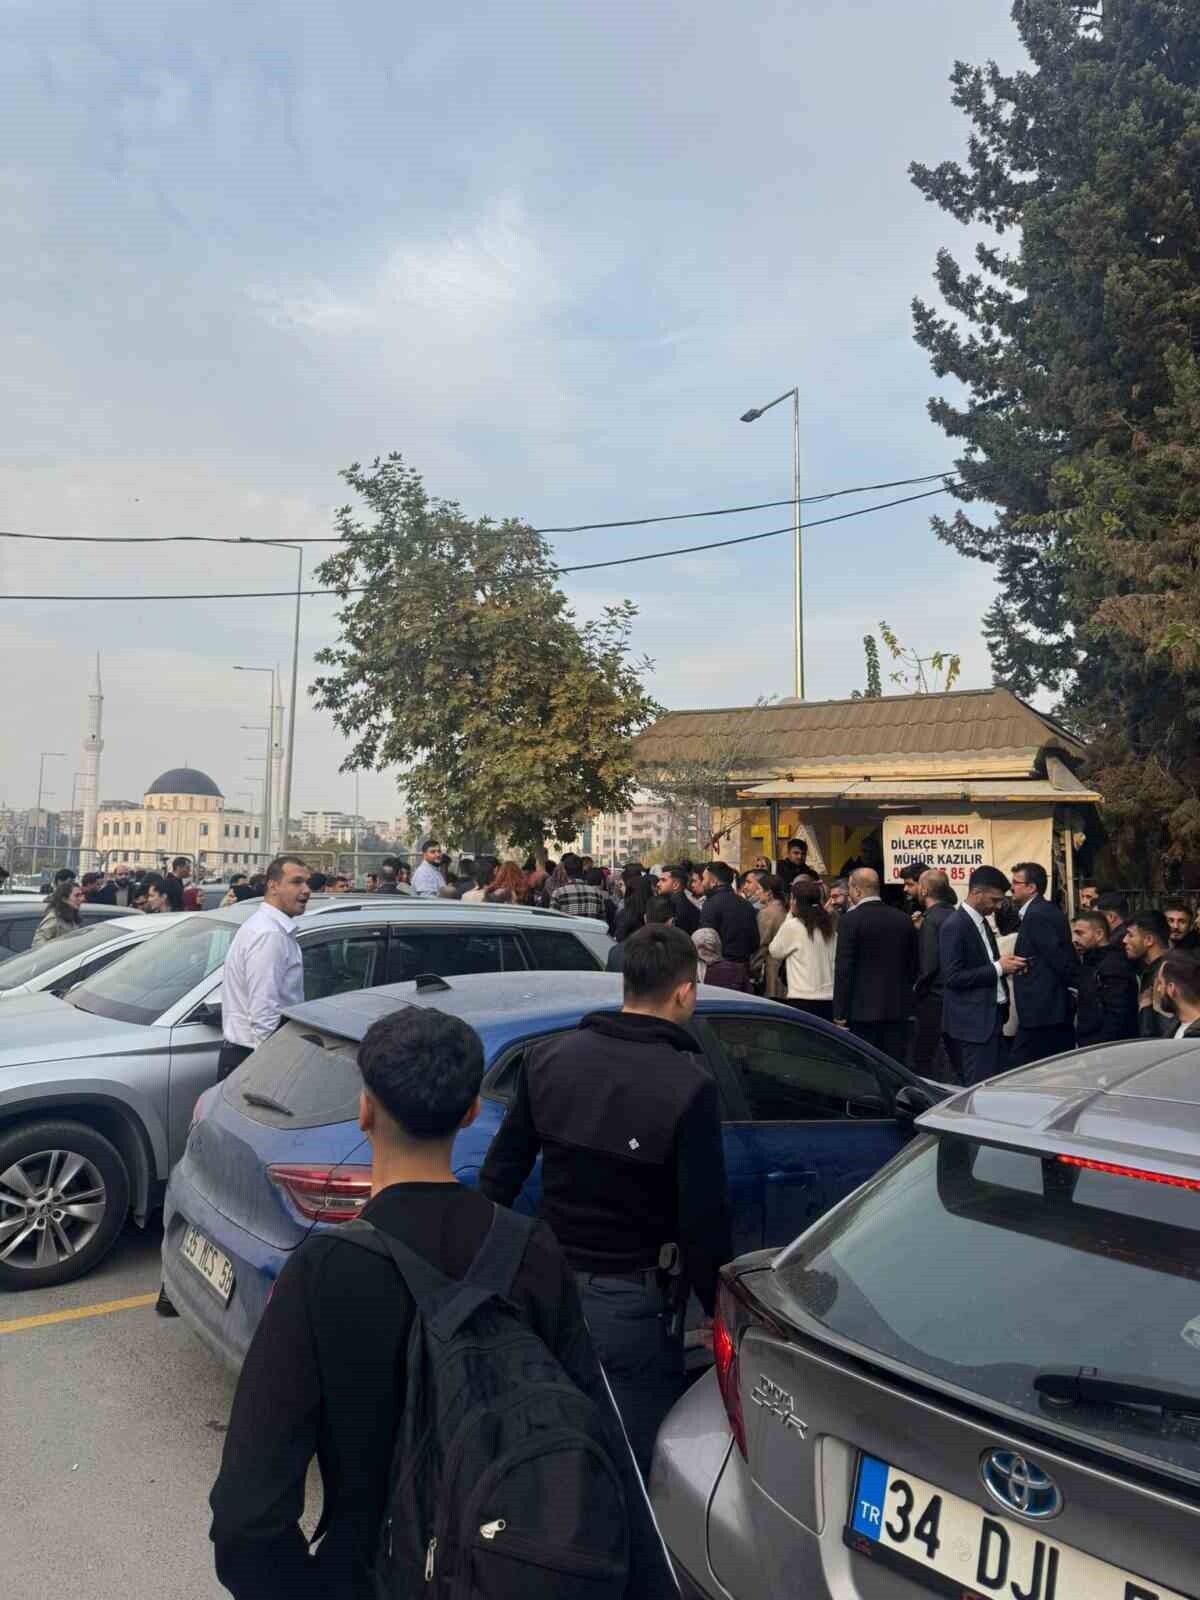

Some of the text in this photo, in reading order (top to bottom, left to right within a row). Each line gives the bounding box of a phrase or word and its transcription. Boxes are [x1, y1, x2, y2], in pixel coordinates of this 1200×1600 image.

[904, 824, 969, 835] ARZUHALCI
[891, 838, 984, 851] DİLEKÇE YAZILIR
[894, 853, 982, 865] MÜHÜR KAZILIR
[950, 867, 965, 880] 85
[860, 1500, 881, 1525] TR
[885, 1479, 943, 1559] 34
